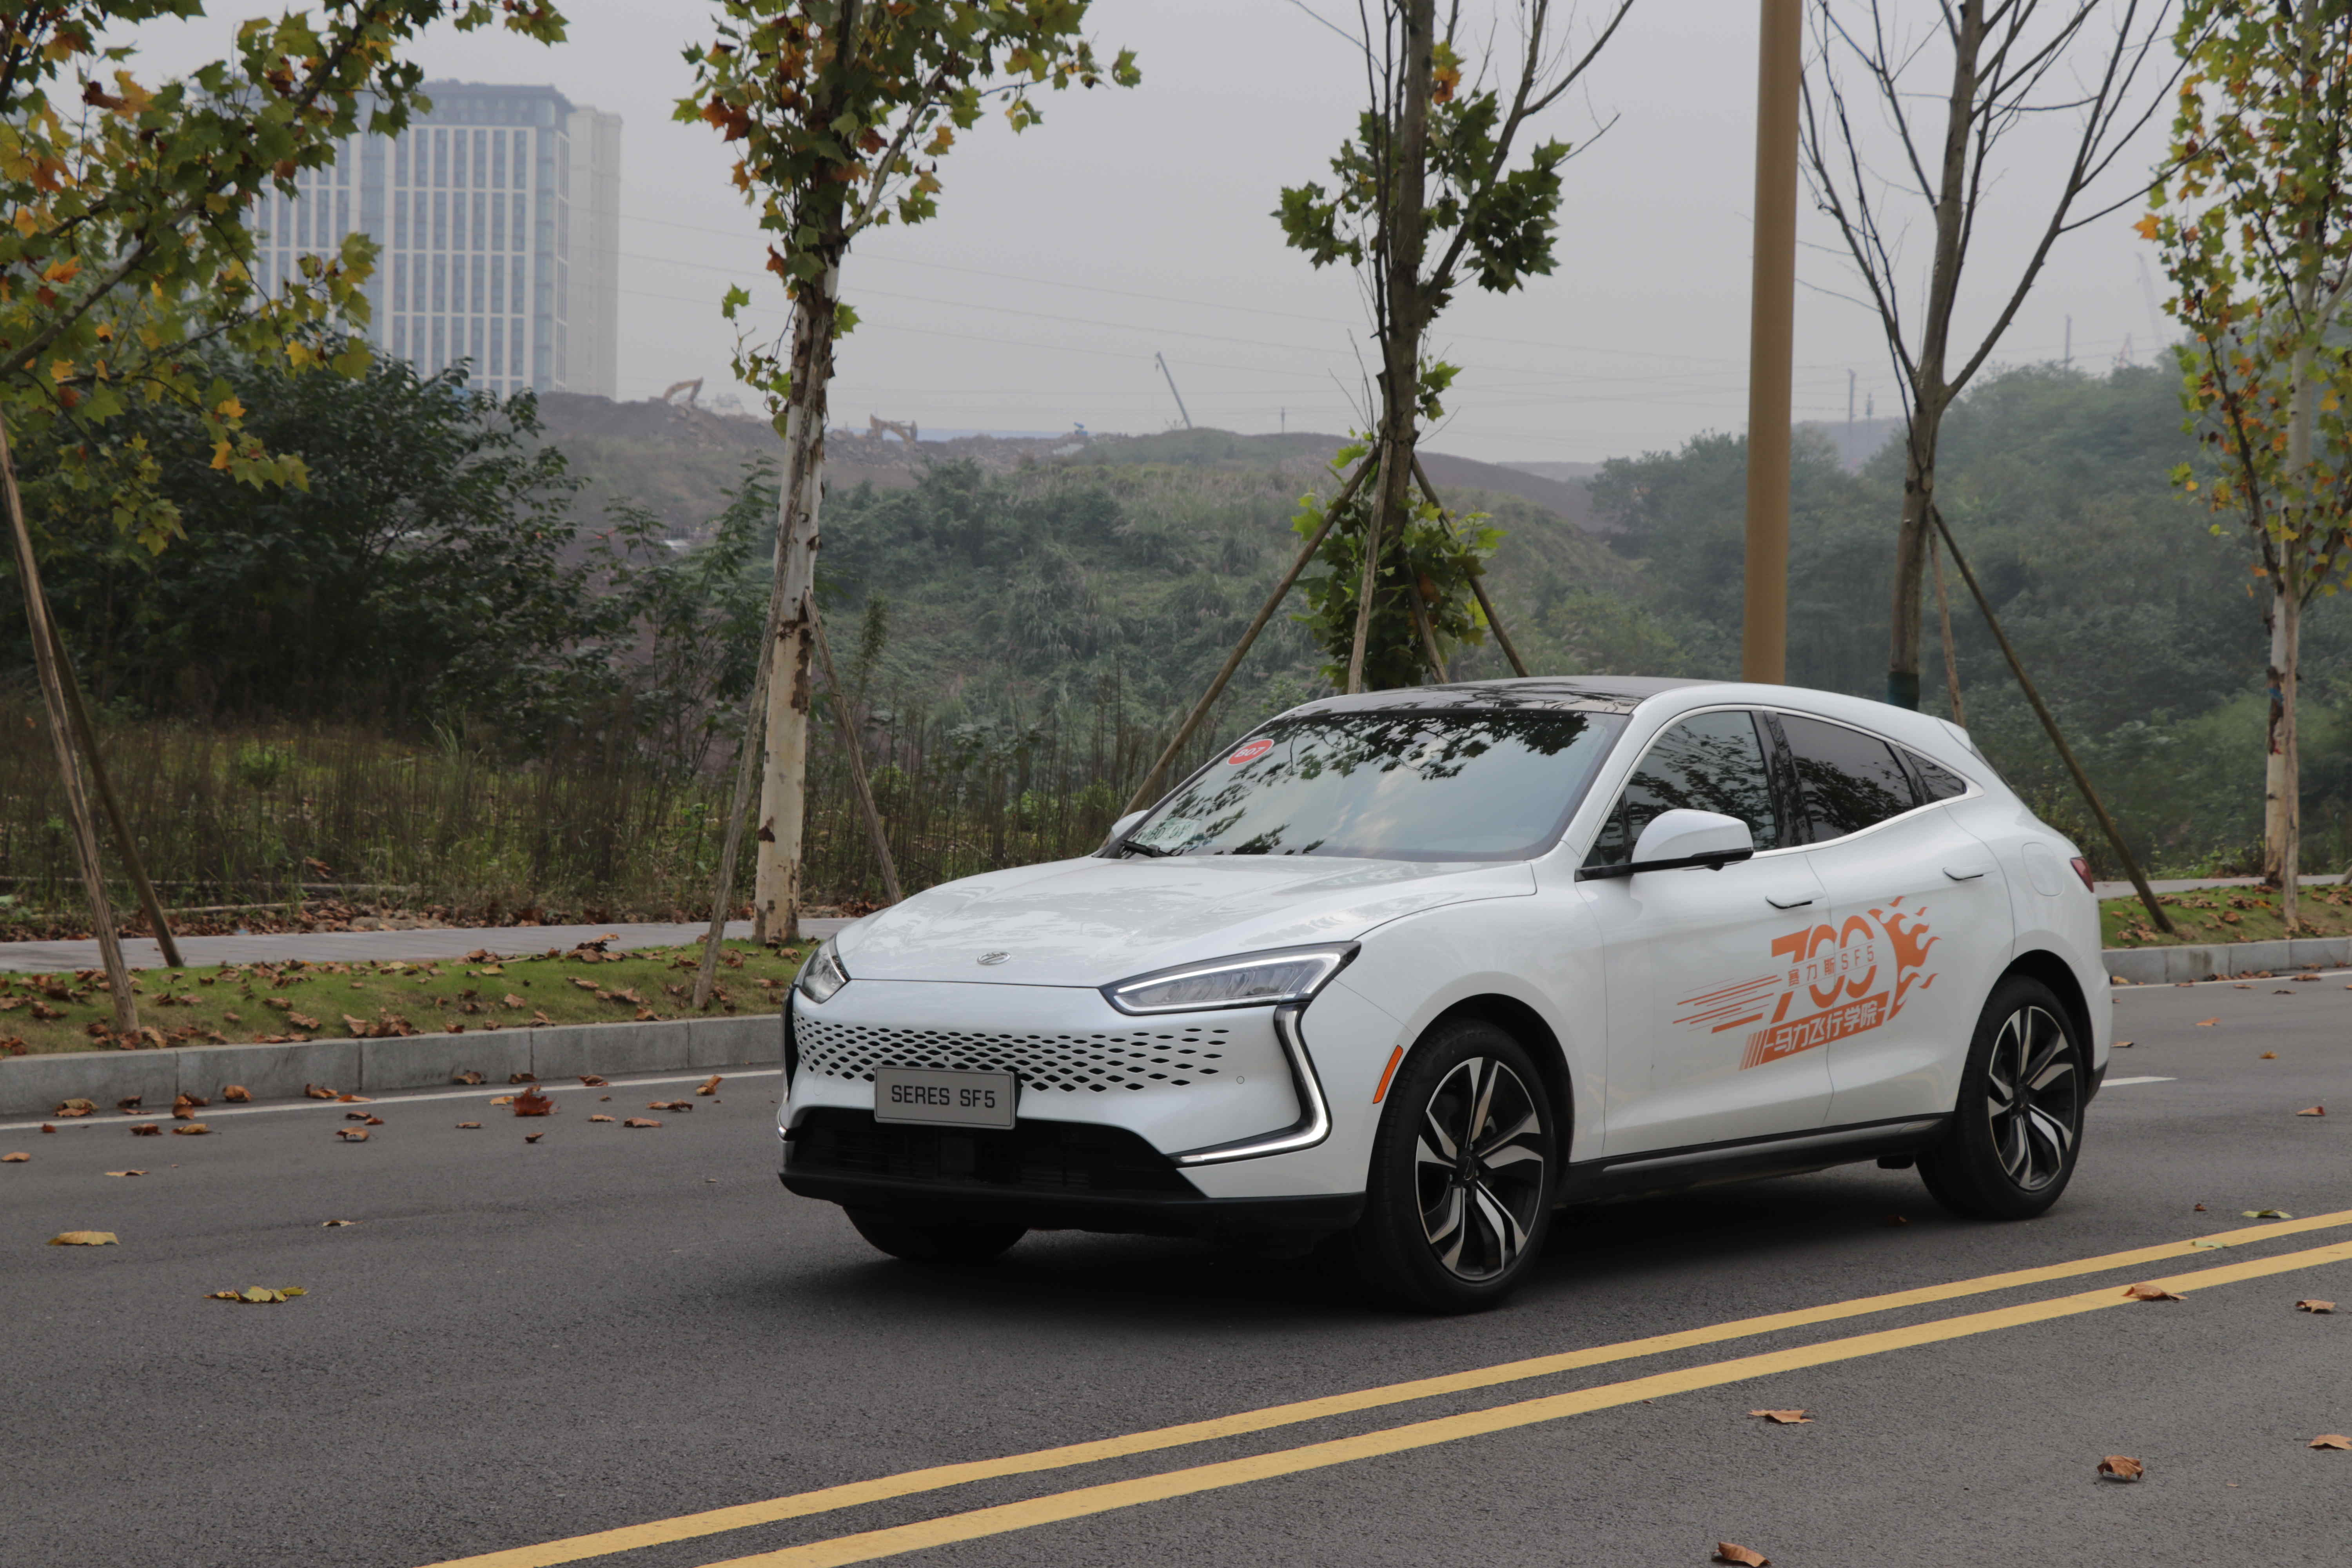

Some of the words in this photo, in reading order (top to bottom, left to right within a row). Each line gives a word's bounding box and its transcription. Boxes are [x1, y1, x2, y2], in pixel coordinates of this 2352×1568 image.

[1771, 915, 1877, 1024] 700
[1841, 945, 1875, 970] SF5
[1773, 1000, 1878, 1052] 马力飞行学院
[891, 1085, 950, 1105] SERES
[960, 1089, 995, 1109] SF5
